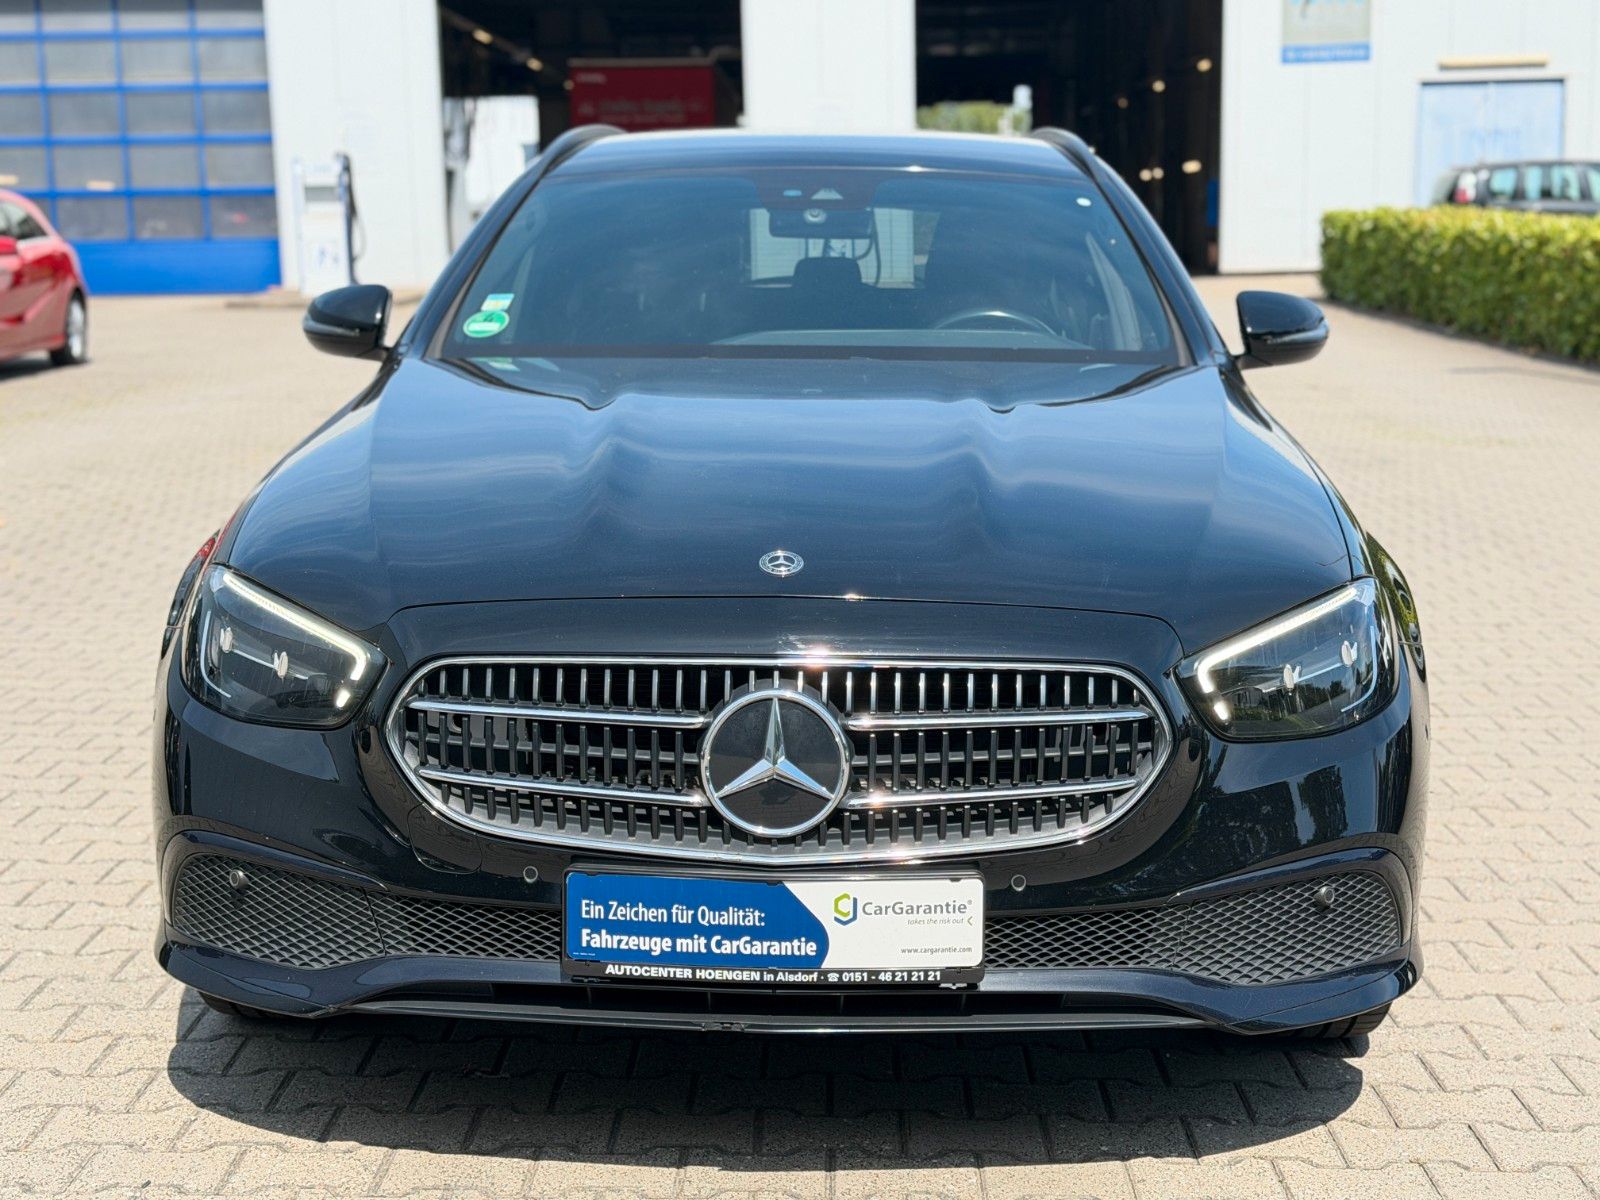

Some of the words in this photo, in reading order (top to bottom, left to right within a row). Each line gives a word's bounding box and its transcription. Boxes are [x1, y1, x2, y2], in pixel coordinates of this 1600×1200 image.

[581, 899, 605, 920] Ein
[608, 901, 668, 923] Zeichen
[671, 904, 695, 924] für
[697, 905, 765, 926] Qualität:
[907, 918, 926, 926] takes
[927, 917, 938, 925] the
[939, 917, 950, 925] risk
[951, 917, 964, 925] out
[581, 928, 672, 956] Fahrzeuge
[676, 934, 707, 953] mit
[710, 935, 818, 956] CarGarantie
[901, 945, 973, 955] www.cargarantie.com
[605, 964, 693, 979] AUTOCENTER
[695, 969, 760, 981] HOENGEN
[763, 971, 774, 981] in
[776, 971, 818, 982] Alsdorf
[842, 971, 868, 982] 0151
[878, 972, 894, 981] 46
[895, 971, 908, 982] 21
[911, 971, 924, 981] 21
[927, 971, 941, 981] 21
